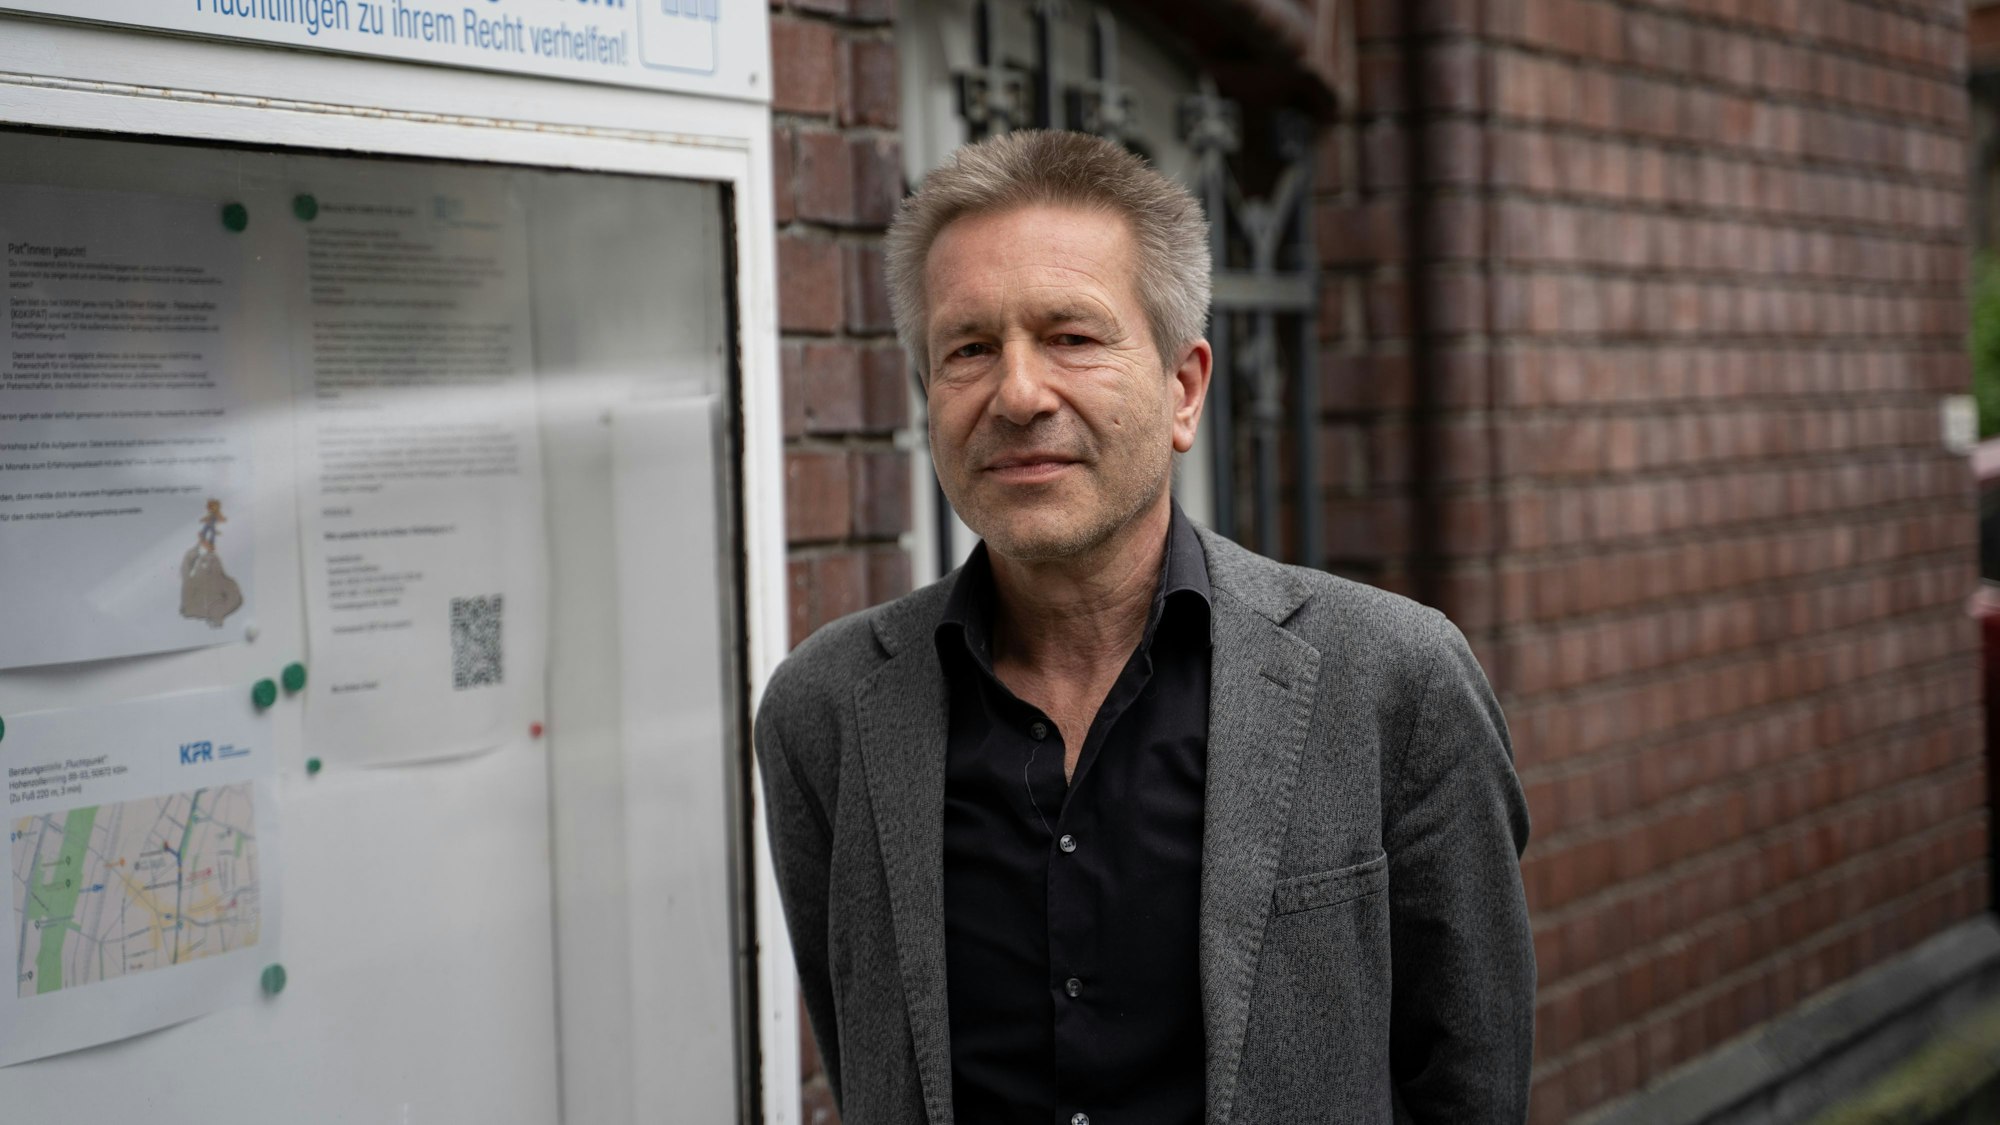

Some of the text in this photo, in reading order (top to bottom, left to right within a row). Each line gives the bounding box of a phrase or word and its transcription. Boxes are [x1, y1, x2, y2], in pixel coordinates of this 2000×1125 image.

[358, 3, 384, 34] zu
[391, 1, 457, 45] ihrem
[463, 8, 524, 53] Recht
[528, 21, 628, 67] verhelfen!
